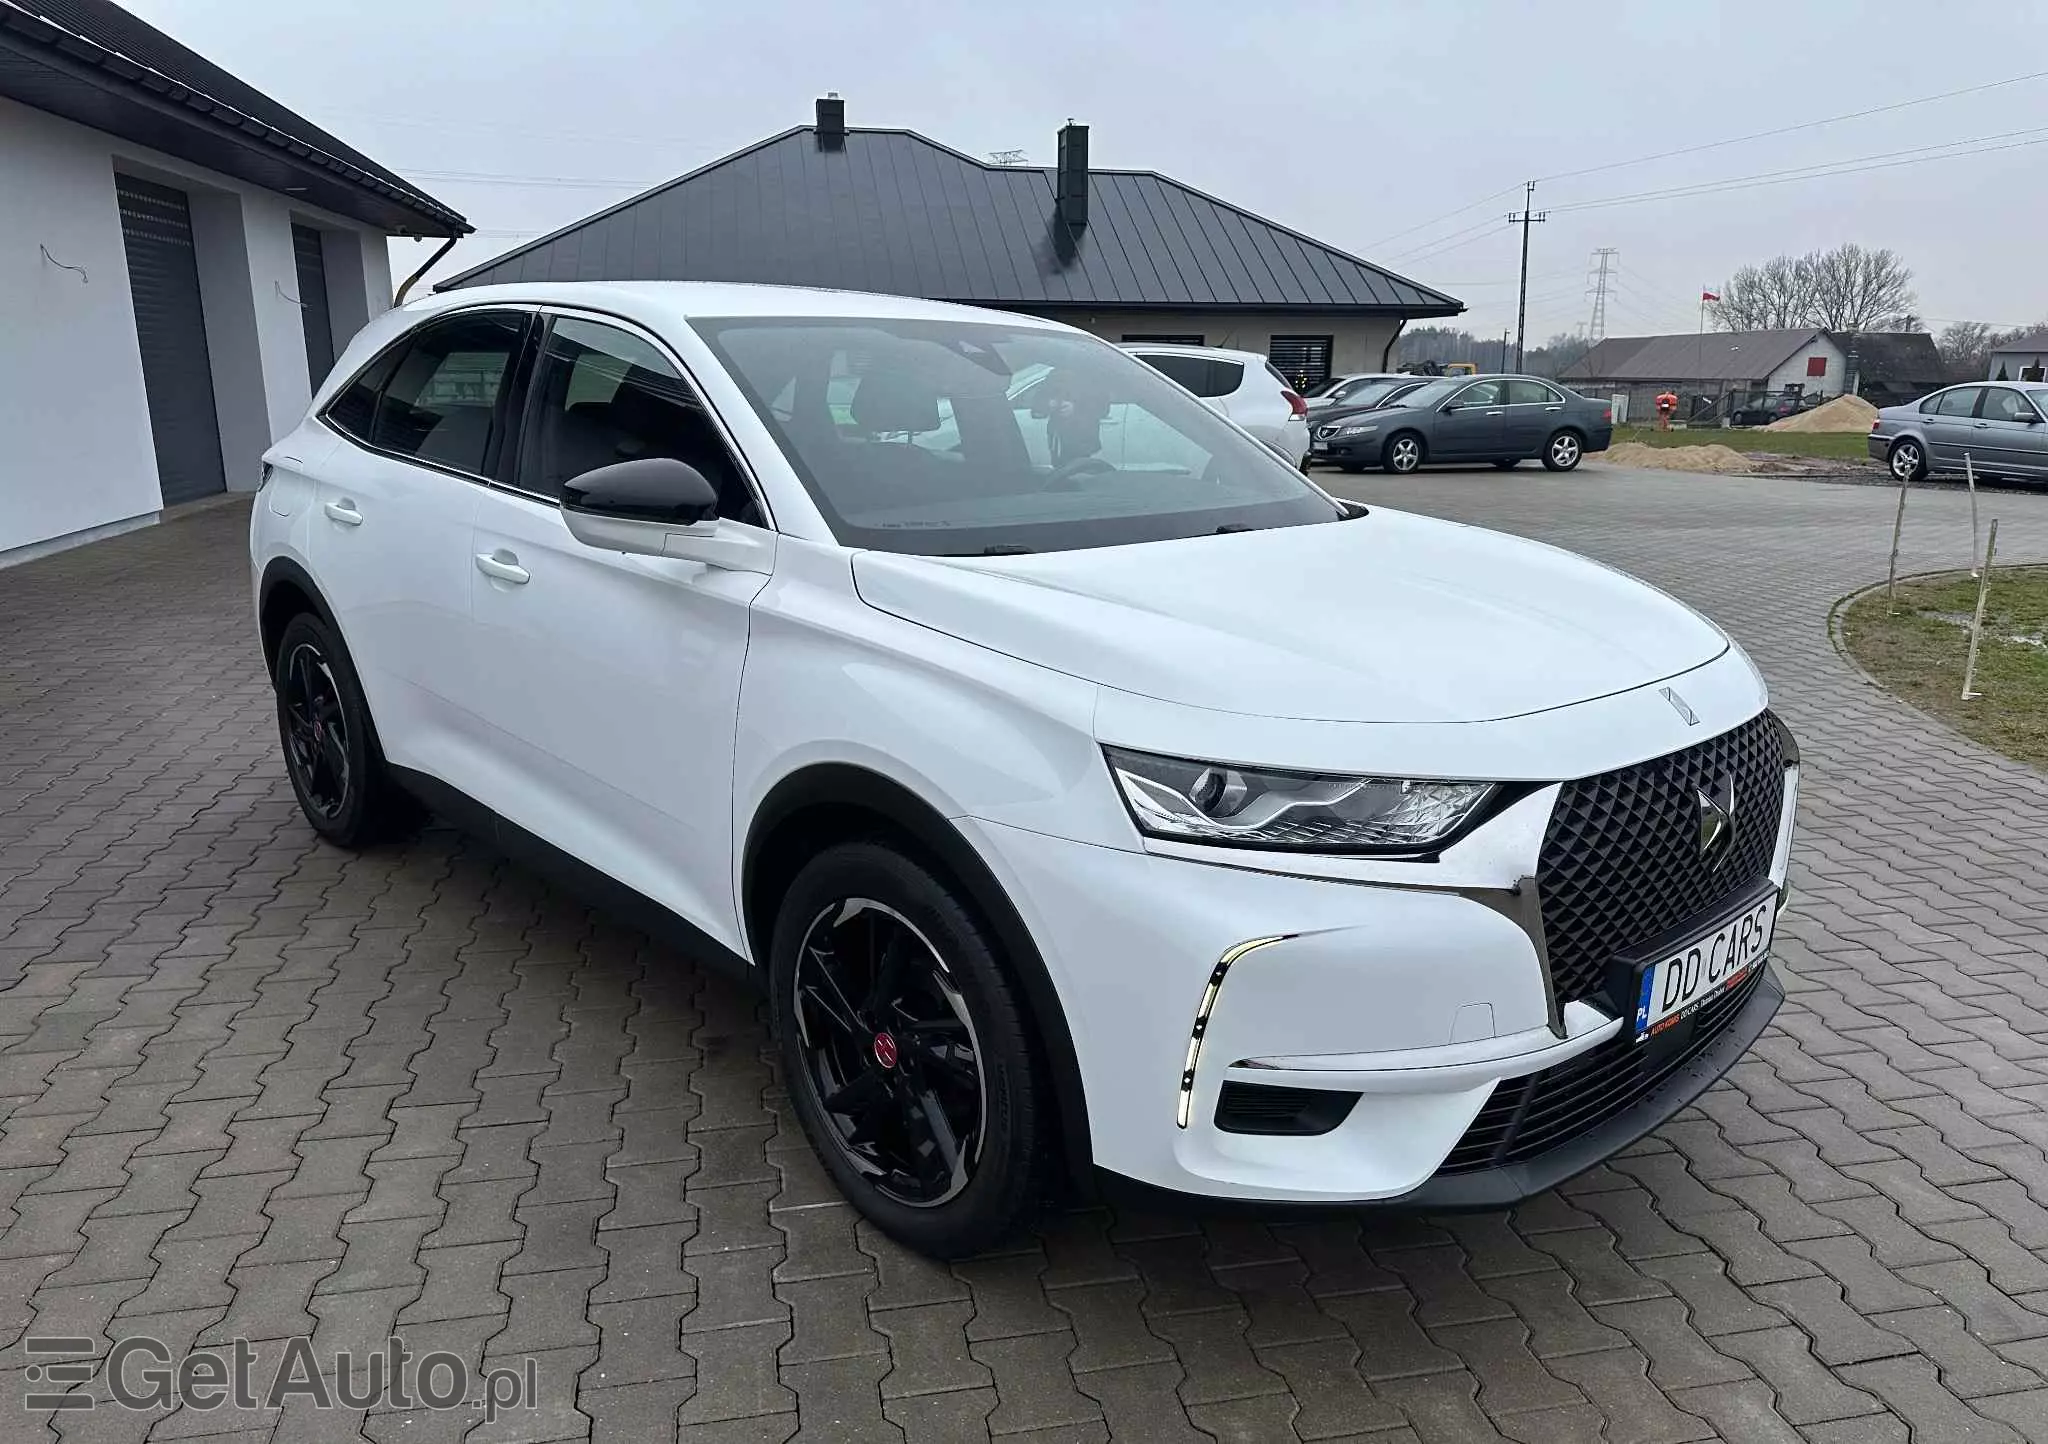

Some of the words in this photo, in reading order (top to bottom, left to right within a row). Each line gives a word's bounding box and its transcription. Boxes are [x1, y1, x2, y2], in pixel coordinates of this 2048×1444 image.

[1662, 948, 1701, 1013] DD
[1709, 905, 1766, 983] CARS
[1636, 1006, 1648, 1022] PL
